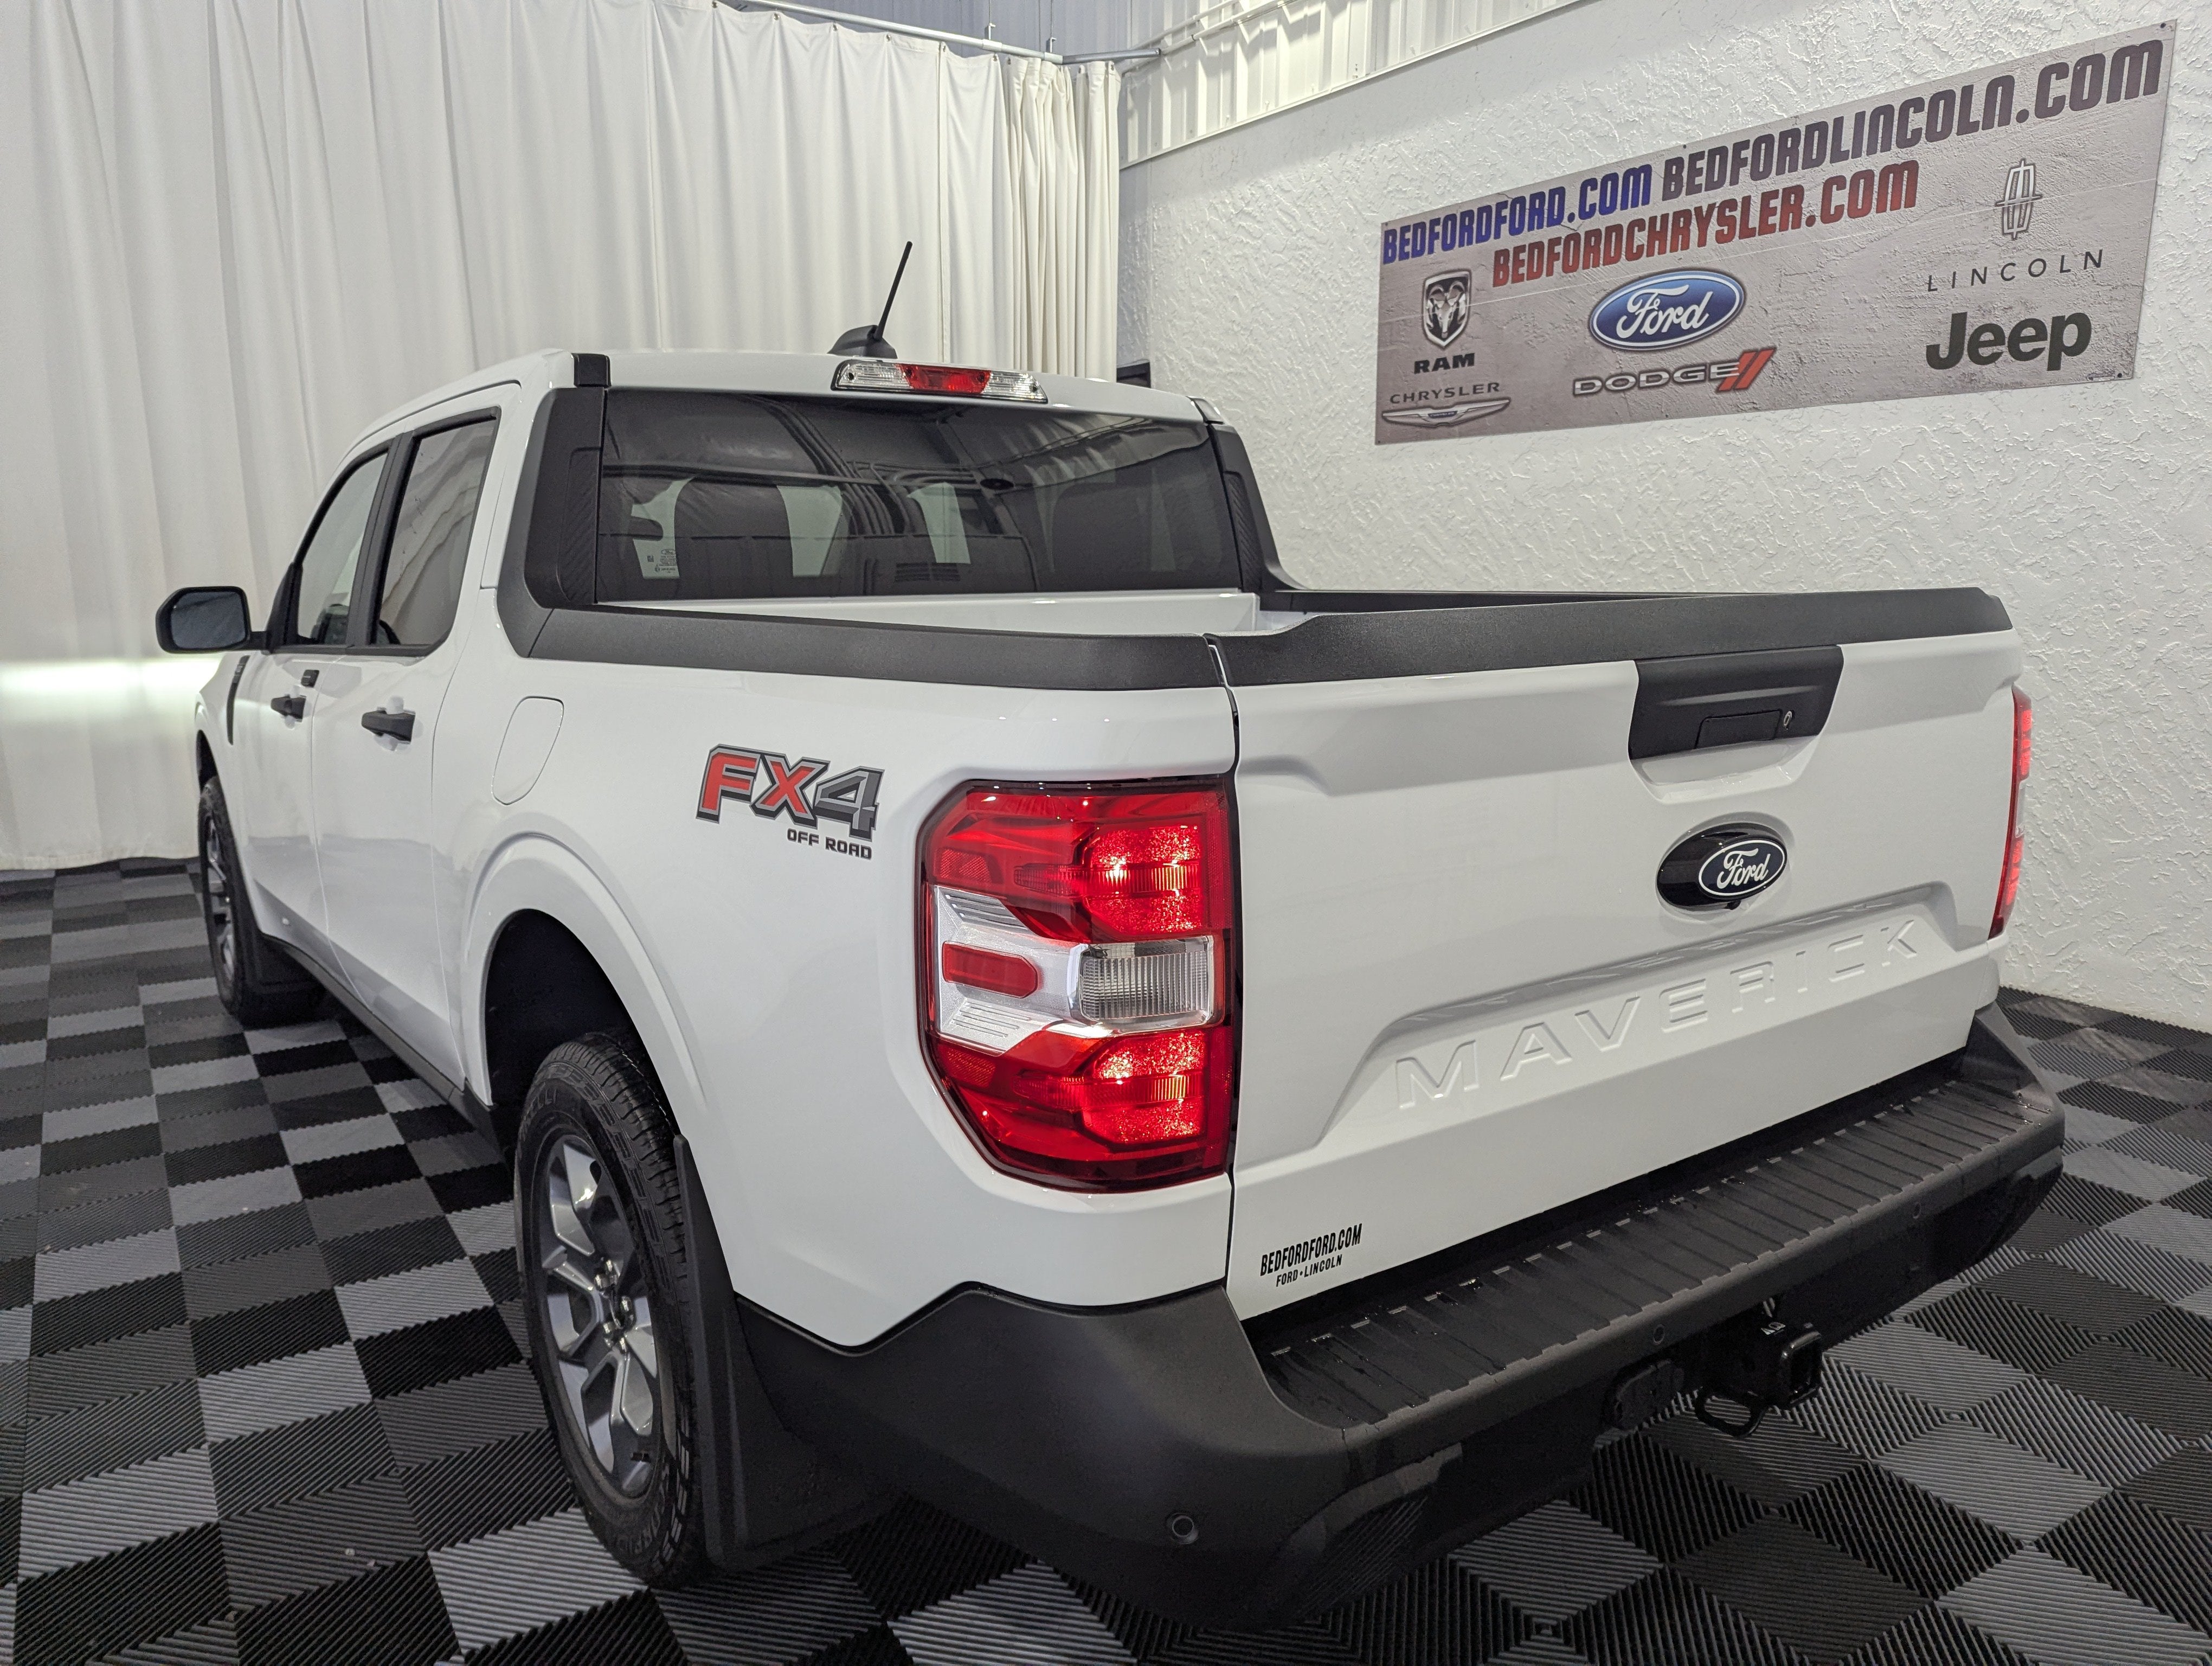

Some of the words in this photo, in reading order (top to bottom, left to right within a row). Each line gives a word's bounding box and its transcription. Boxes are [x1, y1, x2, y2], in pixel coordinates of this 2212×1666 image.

[1383, 164, 1652, 265] BEDFORDFORD.COM
[1661, 39, 2164, 201] BEDFORDLINCOLN.COM
[1492, 159, 1920, 287] BEDFORDCHRYSLER.COM
[1927, 249, 2103, 292] LINCOLN
[1616, 284, 1714, 339] Ford
[1413, 353, 1475, 375] RAM
[1926, 312, 2092, 371] Jeep
[1390, 382, 1500, 404] CHRYSLER
[1573, 361, 1740, 395] DODGE
[696, 744, 885, 842] FX4
[787, 828, 819, 846] OFF
[825, 836, 872, 860] ROAD
[1716, 848, 1771, 889] Ford
[1395, 920, 1918, 1110] MAVERICK
[1260, 1223, 1362, 1277] BEDFORDFORD.COM
